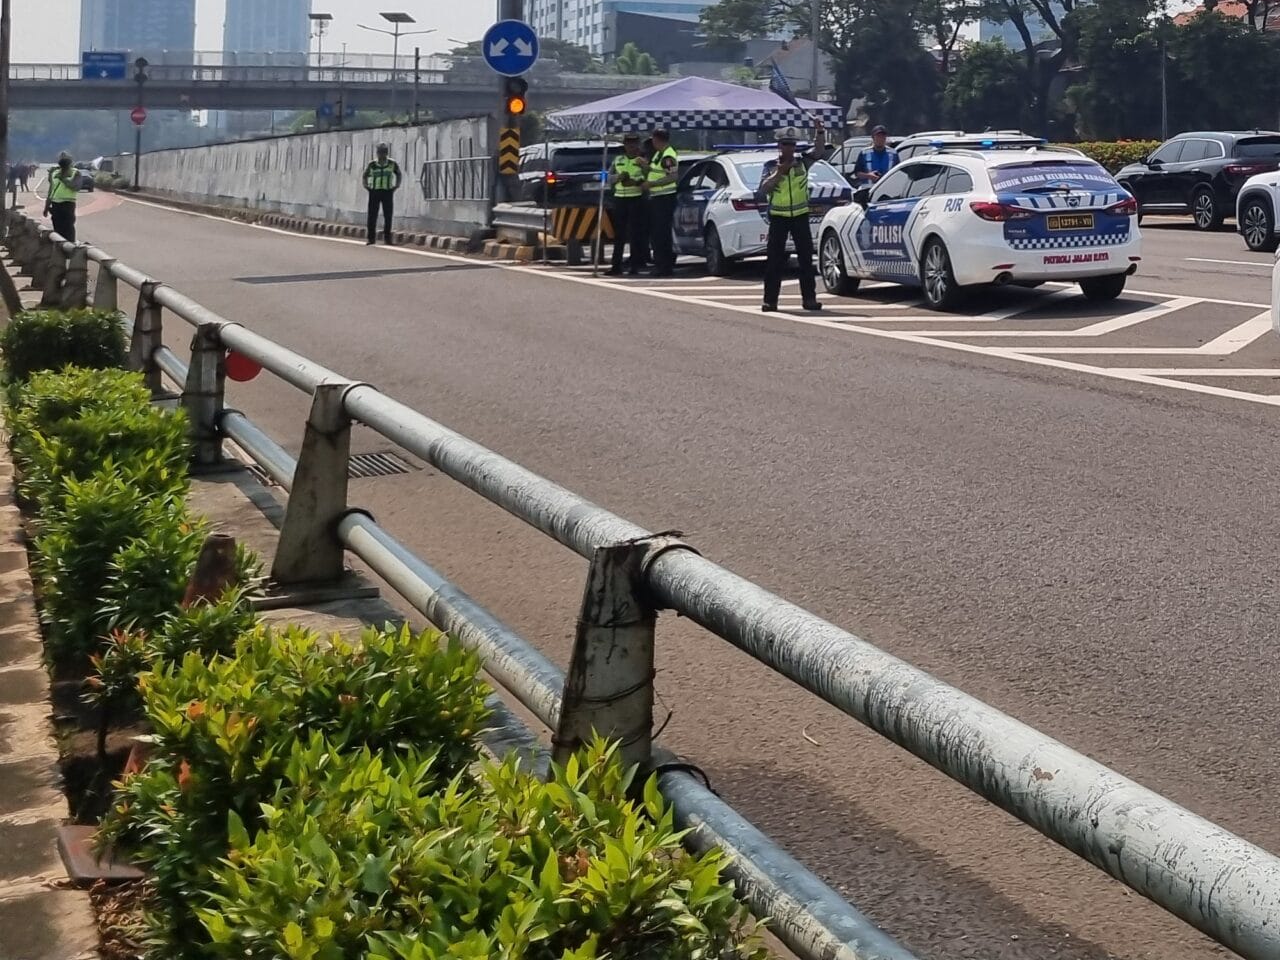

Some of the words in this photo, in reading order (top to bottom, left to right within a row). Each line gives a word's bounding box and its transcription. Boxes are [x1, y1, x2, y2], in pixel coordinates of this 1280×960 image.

[944, 198, 964, 213] PJR
[872, 225, 902, 244] POLISI
[1043, 254, 1072, 265] PATROLI
[1072, 253, 1093, 263] JALAN
